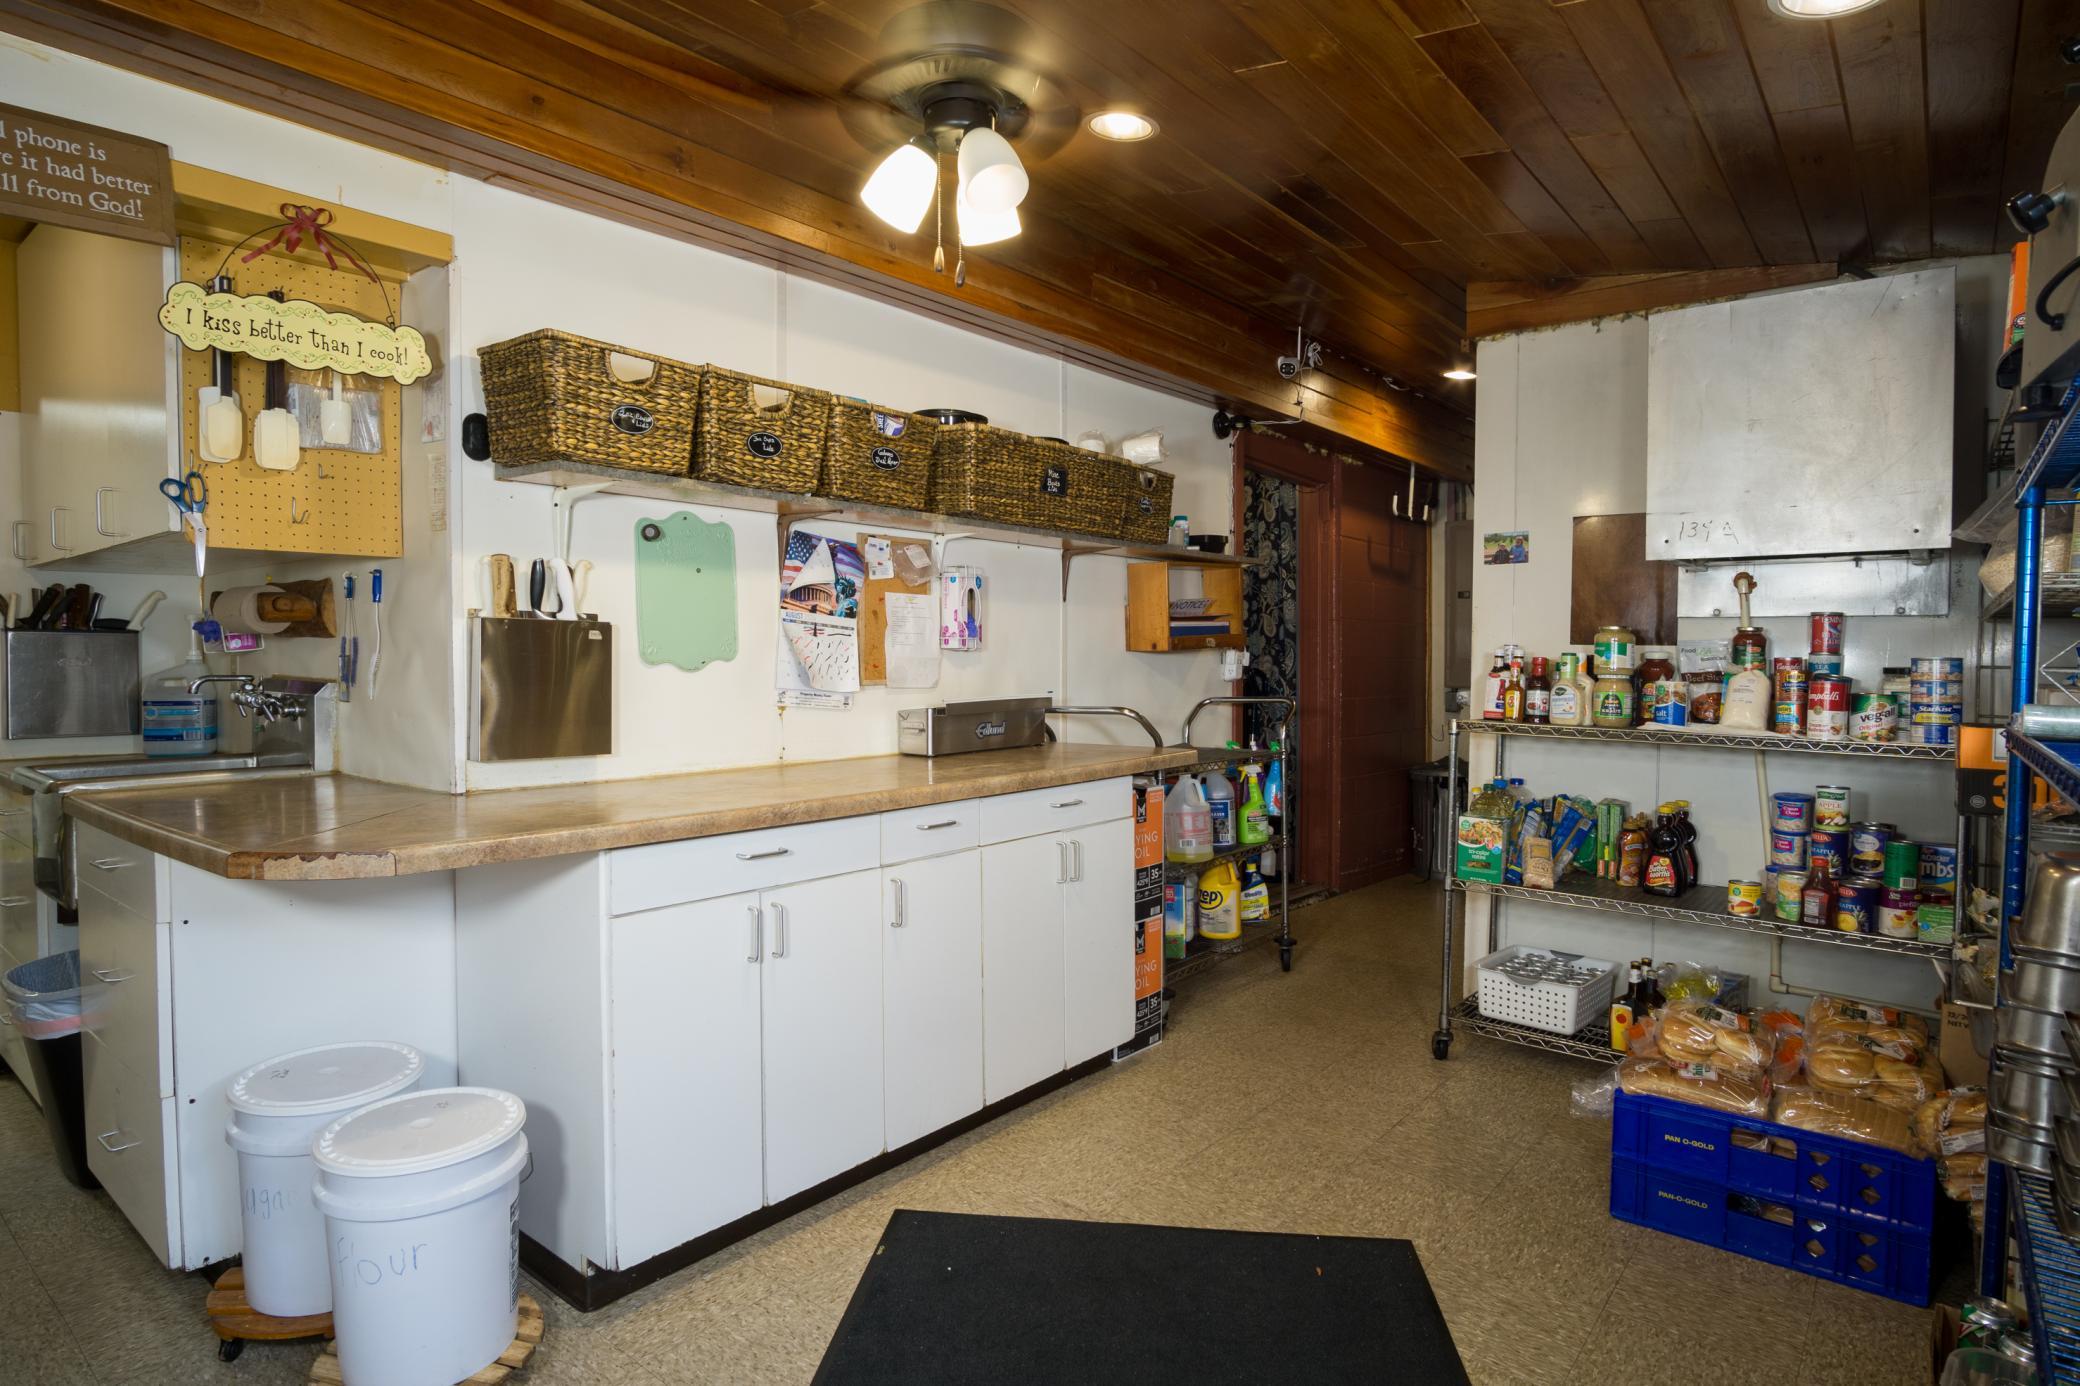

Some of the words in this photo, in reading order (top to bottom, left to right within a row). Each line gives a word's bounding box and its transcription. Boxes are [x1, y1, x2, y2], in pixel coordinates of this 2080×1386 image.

[14, 127, 82, 155] phone
[88, 142, 107, 161] is
[21, 151, 38, 171] it
[46, 156, 85, 182] had
[91, 166, 152, 195] better
[0, 172, 19, 193] ll
[26, 178, 83, 206] from
[88, 191, 144, 218] God!
[186, 307, 192, 325] I
[203, 310, 241, 336] kiss
[249, 318, 303, 345] better
[307, 328, 350, 356] than
[356, 340, 364, 358] I
[369, 343, 409, 367] cook!
[1656, 708, 1669, 718] salt
[976, 722, 1006, 738] Edlund
[1135, 831, 1159, 845] YING
[1150, 868, 1159, 880] 35
[1135, 959, 1158, 977] YING
[1658, 1190, 1709, 1209] PAN-O-GOLD
